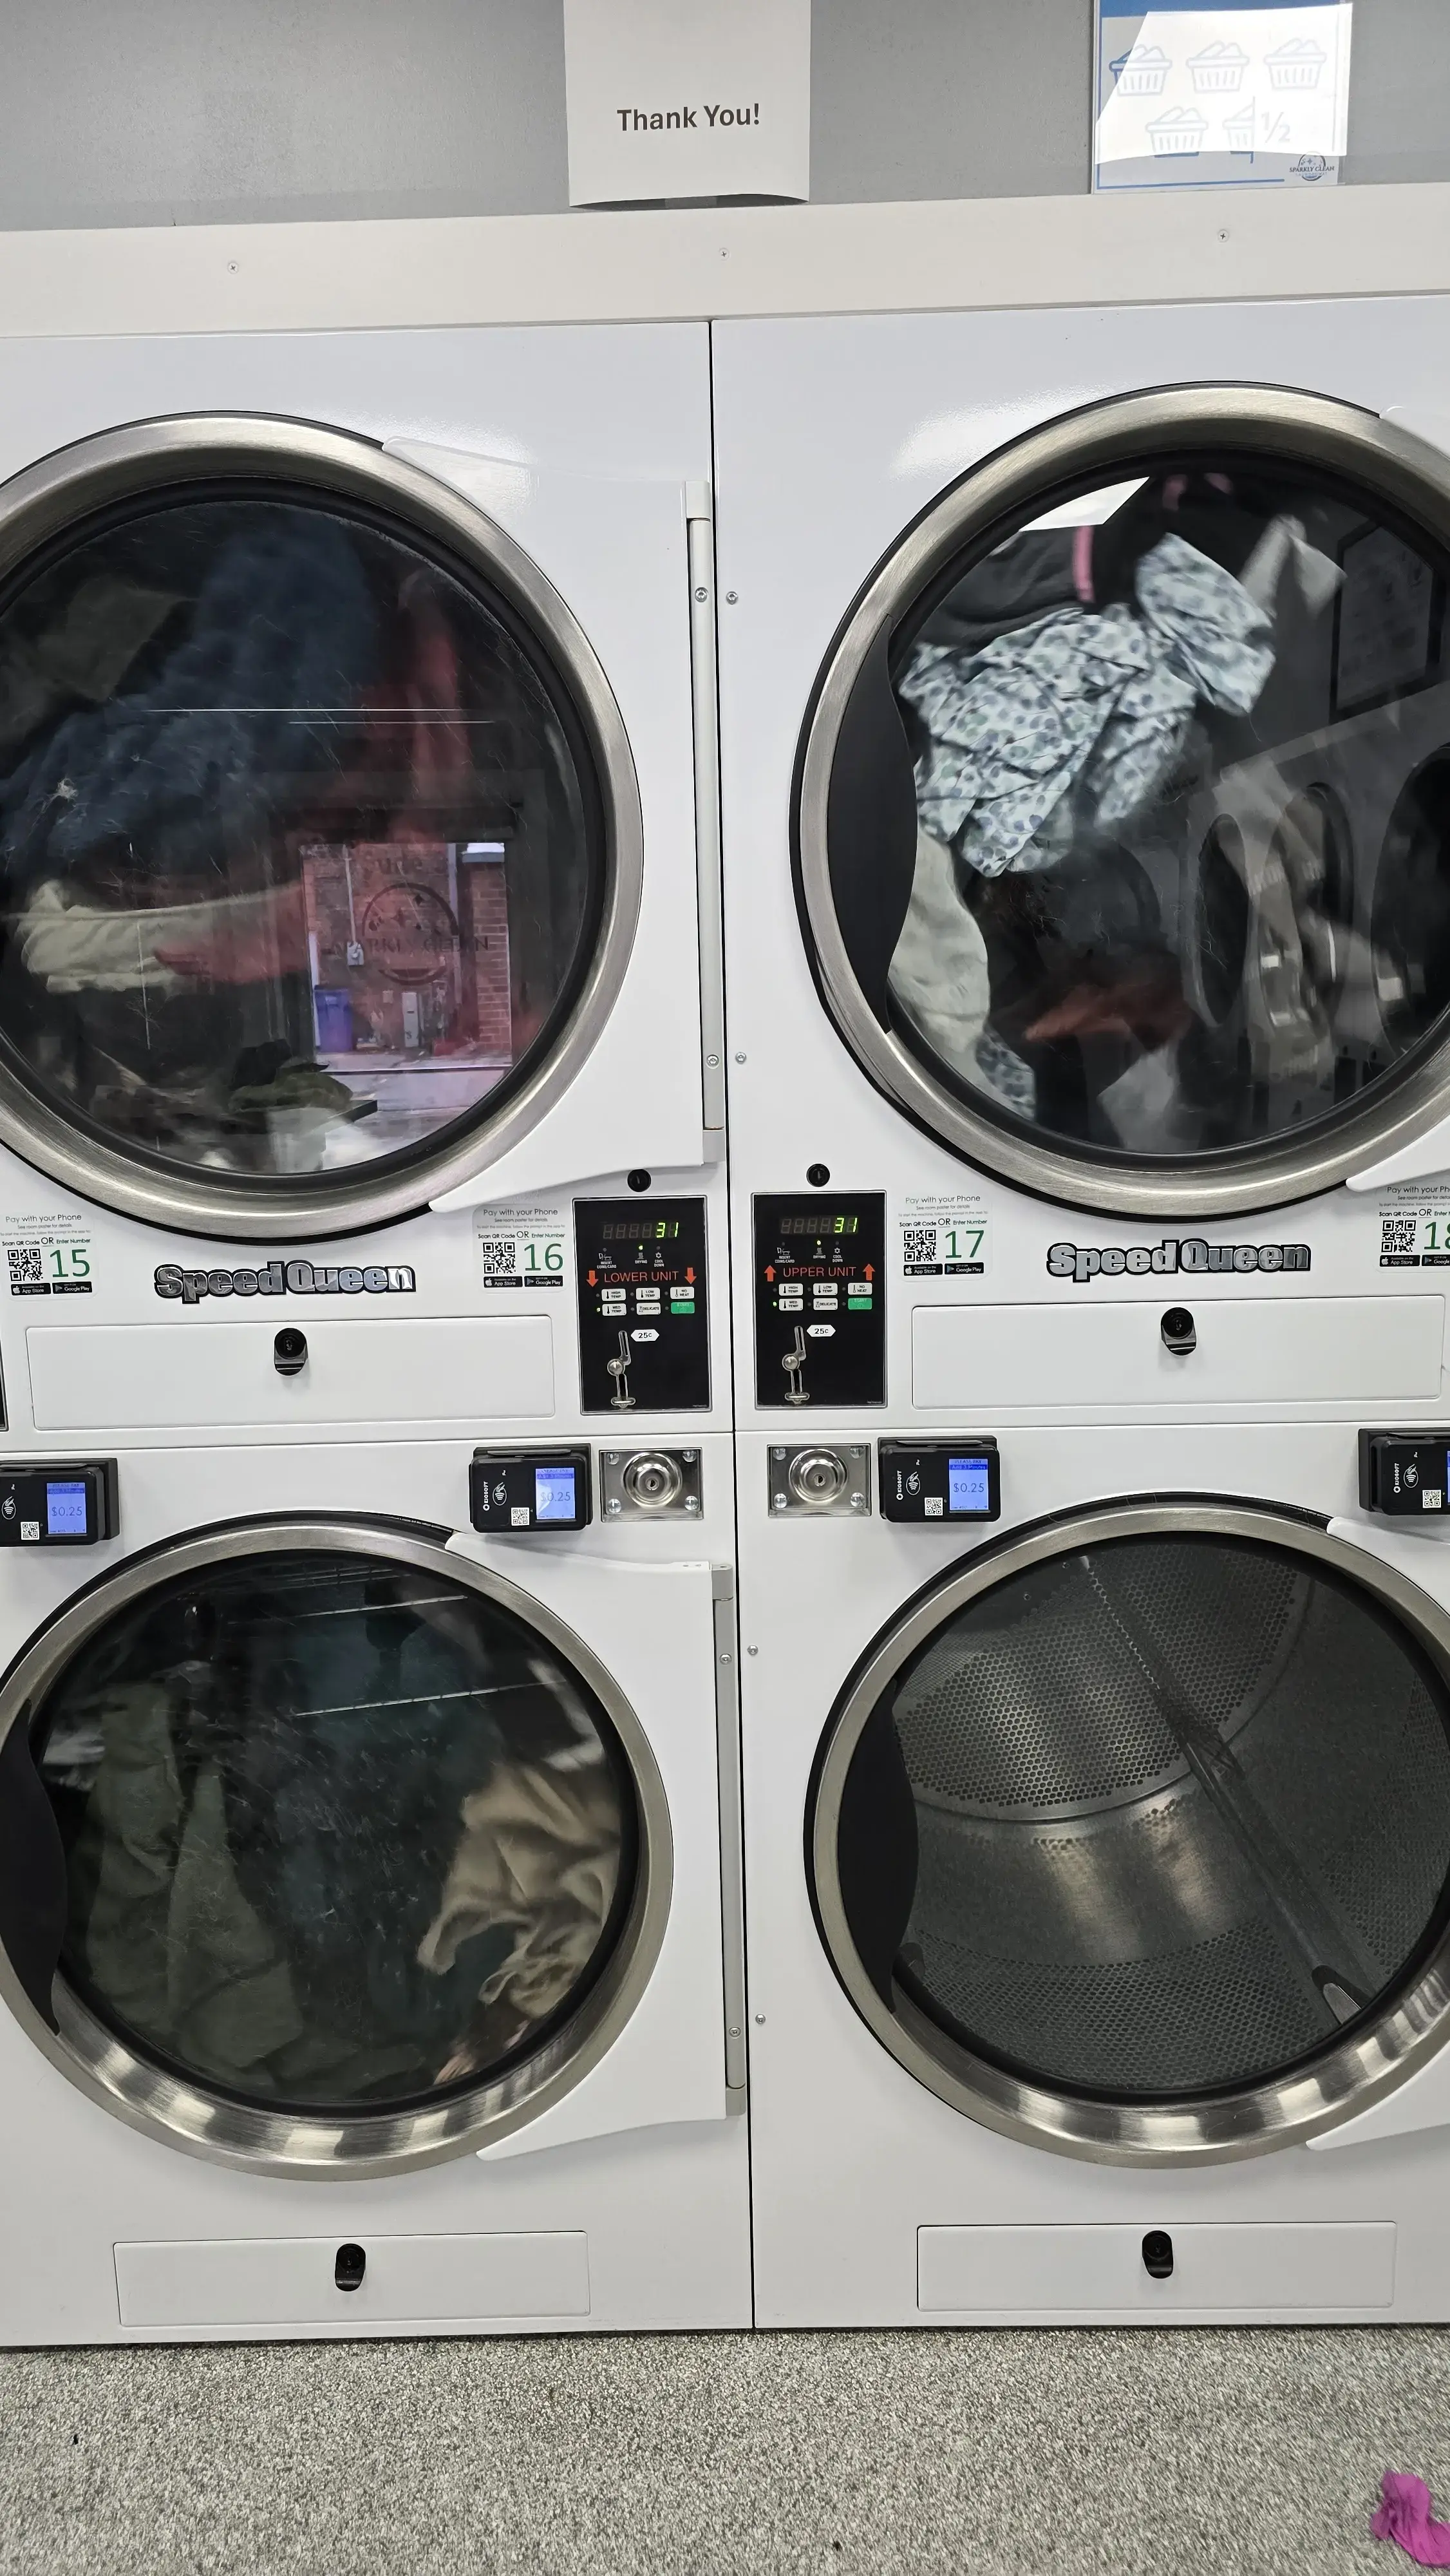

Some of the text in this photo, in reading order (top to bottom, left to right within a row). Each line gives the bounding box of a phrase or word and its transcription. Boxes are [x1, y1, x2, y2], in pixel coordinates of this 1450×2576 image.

[616, 103, 759, 131] Thank You!
[656, 1222, 679, 1238] 31
[834, 1217, 858, 1233] 31
[1424, 1222, 1450, 1249] 1
[945, 1230, 984, 1258] 17
[50, 1249, 90, 1278] 15
[524, 1244, 563, 1271] 16
[1046, 1238, 1311, 1283] Speed Queen
[155, 1260, 416, 1304] Speed Queen
[604, 1271, 679, 1283] LOWER UNIT
[783, 1267, 856, 1278] UPPER UNIT
[540, 1492, 571, 1502] $0.25
[953, 1483, 984, 1493] $0.25
[52, 1506, 82, 1517] $0.25
